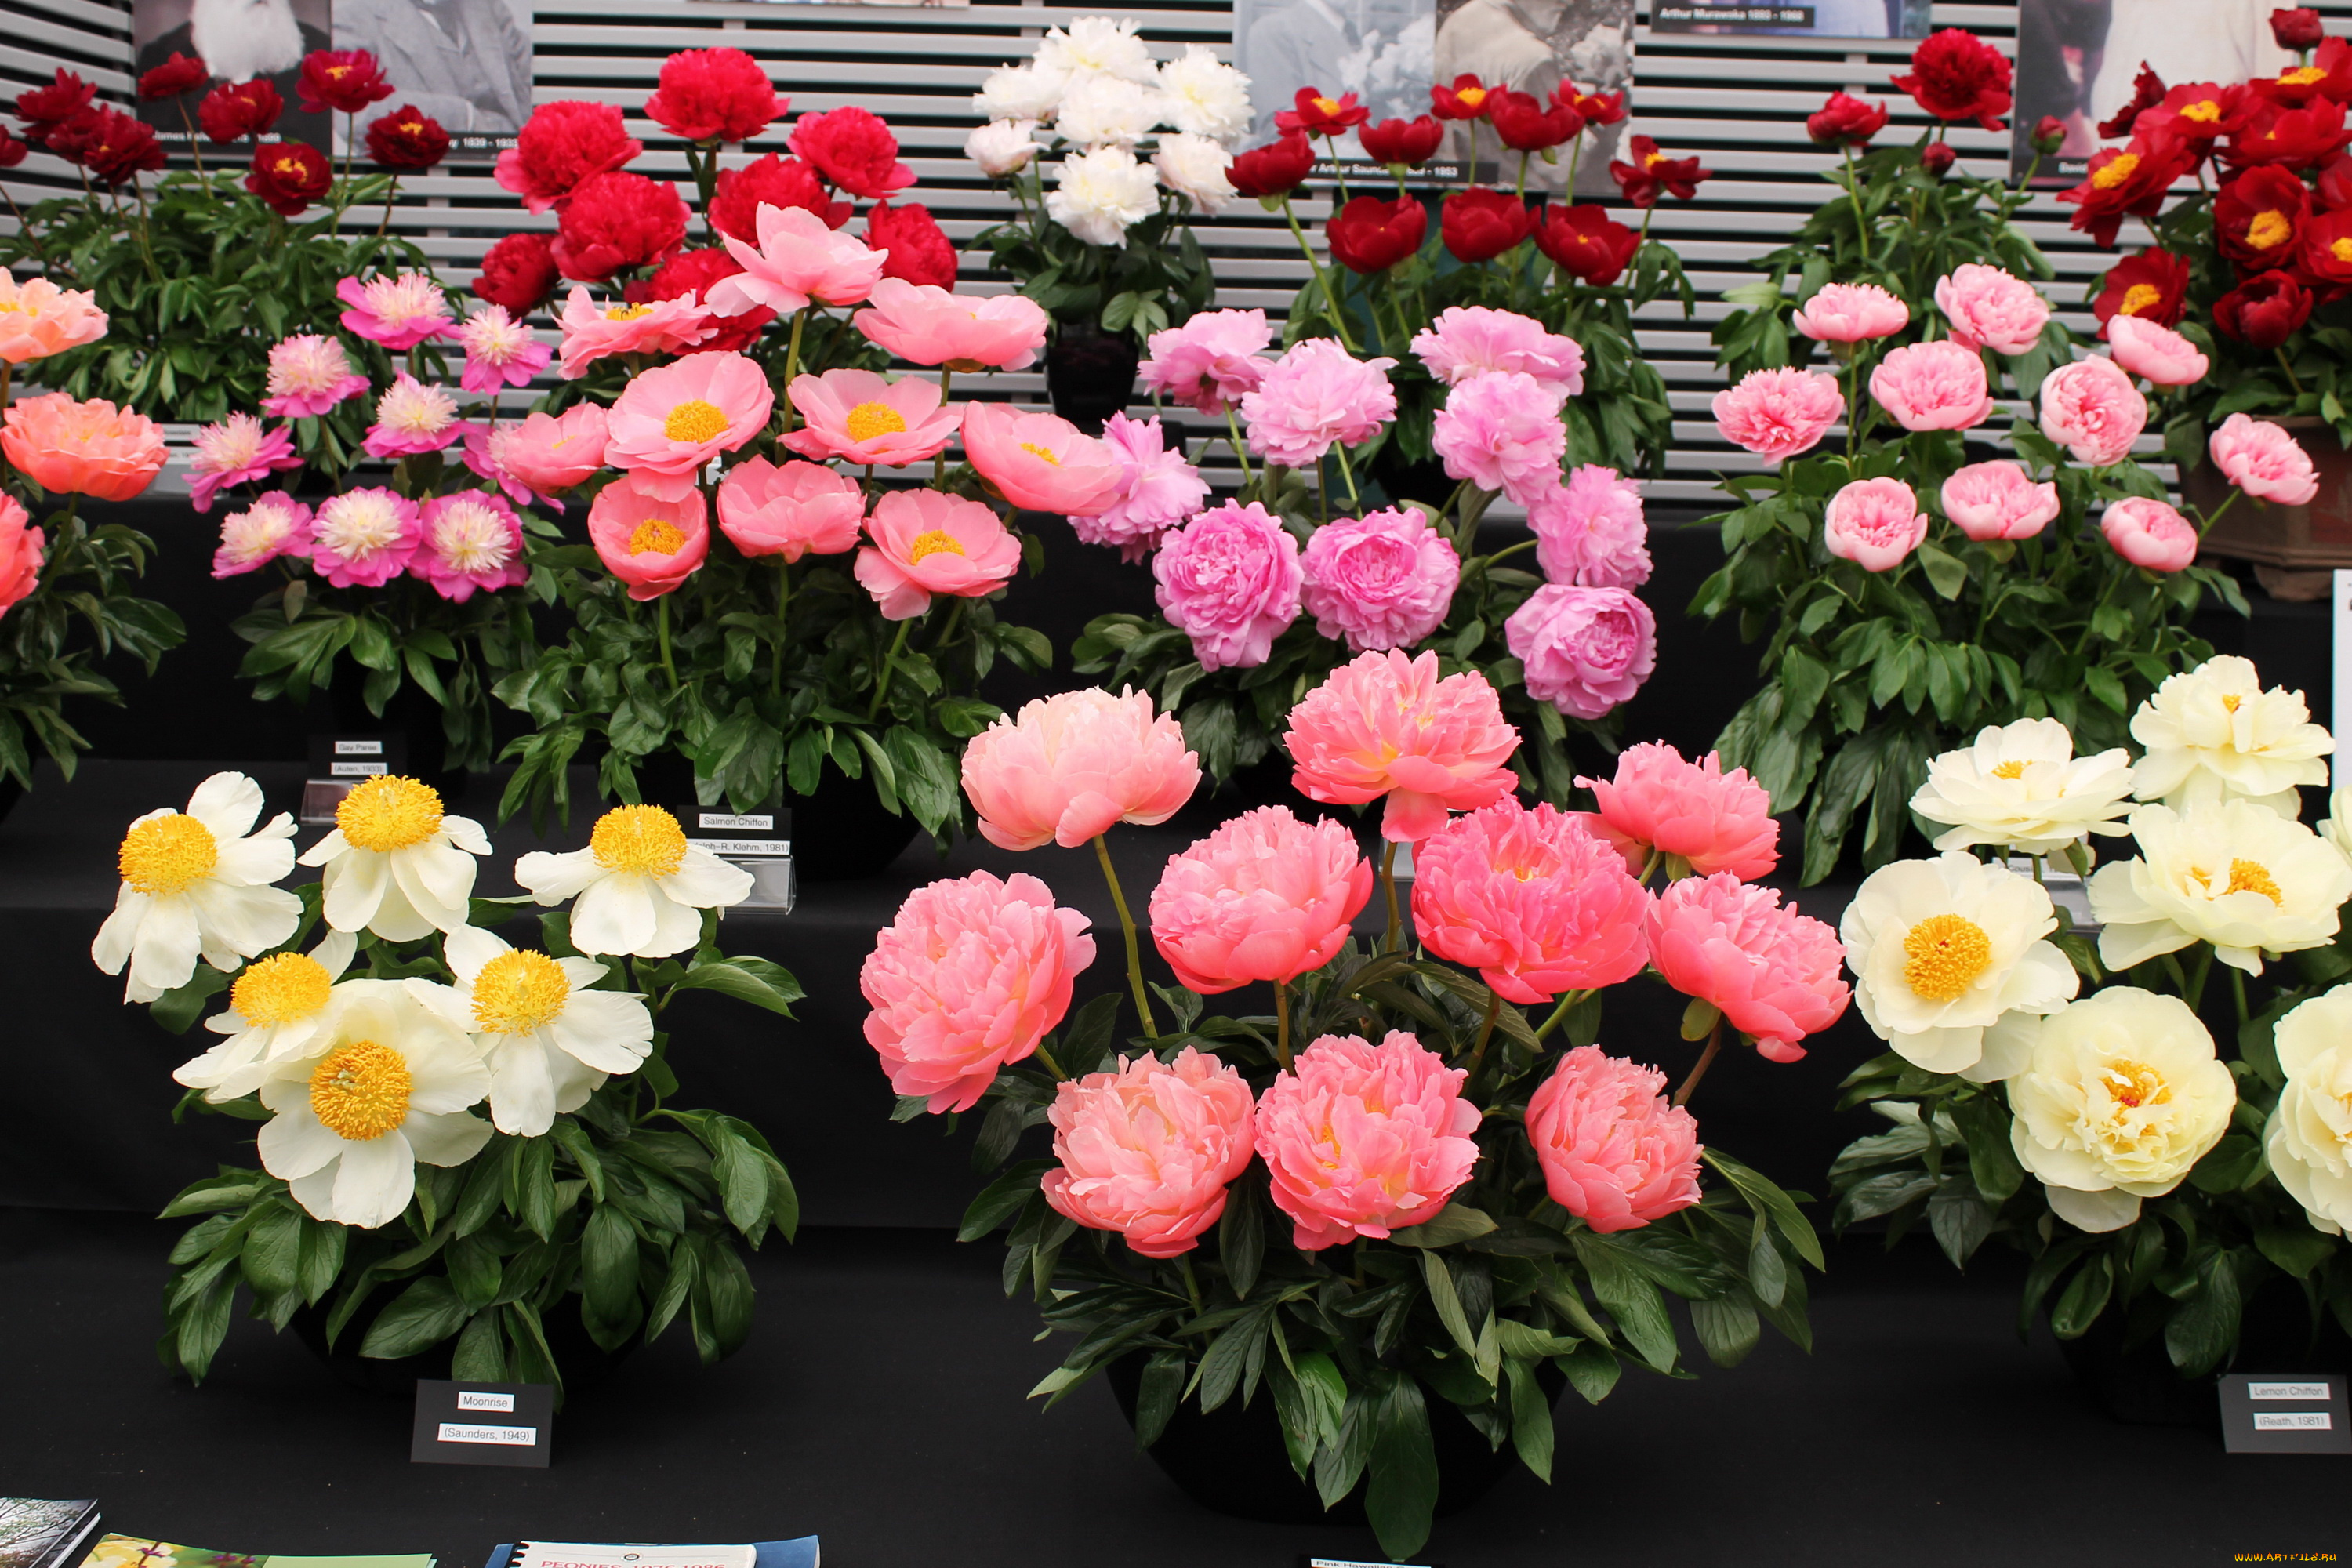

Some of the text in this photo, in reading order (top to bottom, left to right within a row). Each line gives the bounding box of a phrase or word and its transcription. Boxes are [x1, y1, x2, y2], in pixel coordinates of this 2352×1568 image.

[703, 816, 768, 827] Salmon Chiffon
[765, 843, 789, 852] 1981)
[2253, 1386, 2324, 1396] Lemon Chiffon
[462, 1396, 508, 1408] Moonrise
[2297, 1416, 2325, 1426] 1981)
[443, 1427, 530, 1442] (Saunders, 1949)
